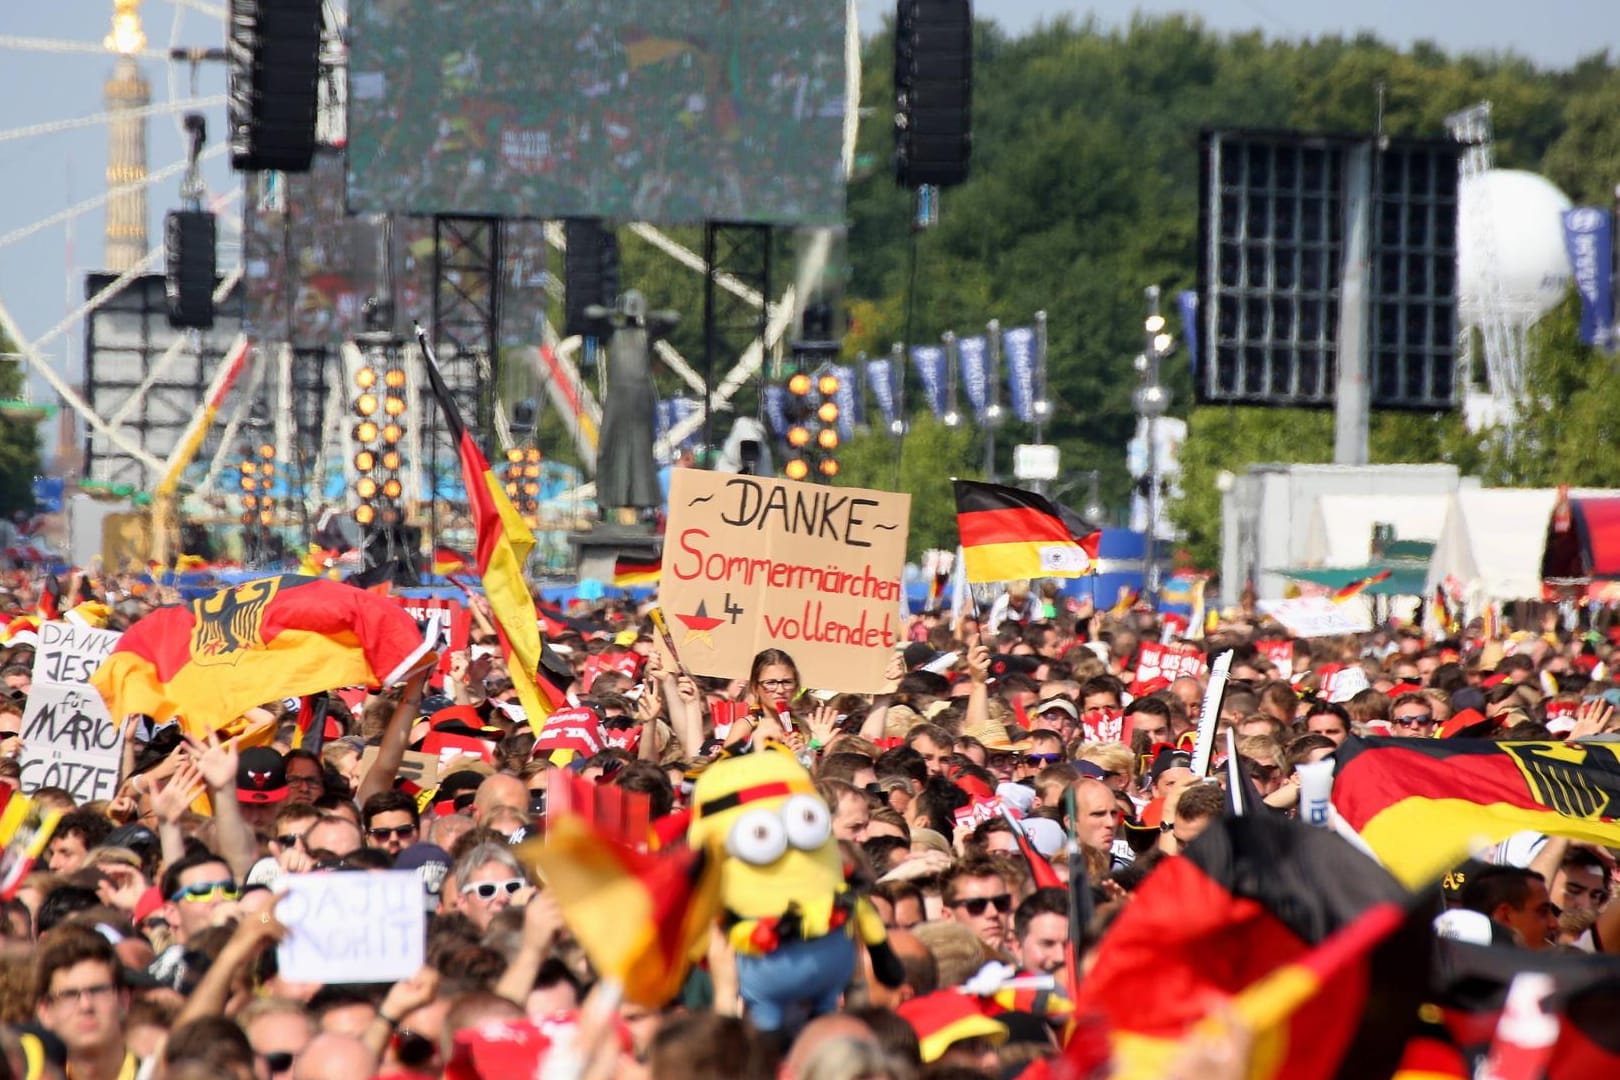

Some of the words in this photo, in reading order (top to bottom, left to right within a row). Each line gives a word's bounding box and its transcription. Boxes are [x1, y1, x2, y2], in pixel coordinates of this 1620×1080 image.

[720, 478, 879, 548] DANKE
[673, 528, 901, 602] Sommermärchen
[723, 592, 744, 625] 4
[763, 600, 896, 649] vollendet
[45, 651, 101, 684] JES
[60, 690, 92, 714] für
[23, 703, 121, 750] MARIO
